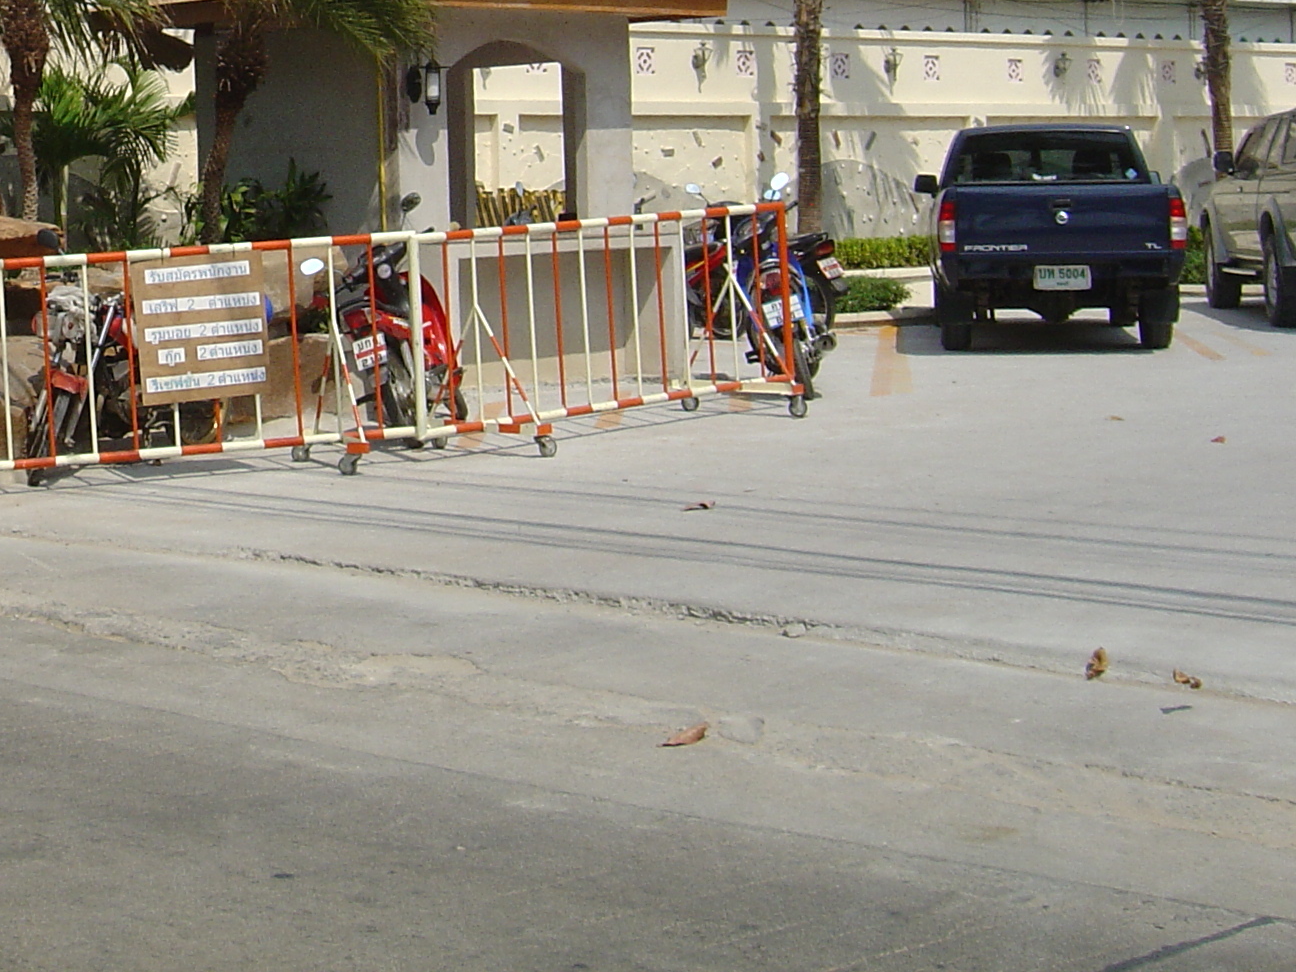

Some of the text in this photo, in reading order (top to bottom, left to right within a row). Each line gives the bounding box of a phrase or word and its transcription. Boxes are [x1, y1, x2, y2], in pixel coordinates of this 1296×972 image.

[964, 244, 1028, 252] FRONTIER
[1058, 268, 1085, 279] 5004
[187, 298, 195, 311] 2
[199, 324, 207, 336] 2
[199, 347, 207, 359] 2
[207, 373, 216, 386] 2
